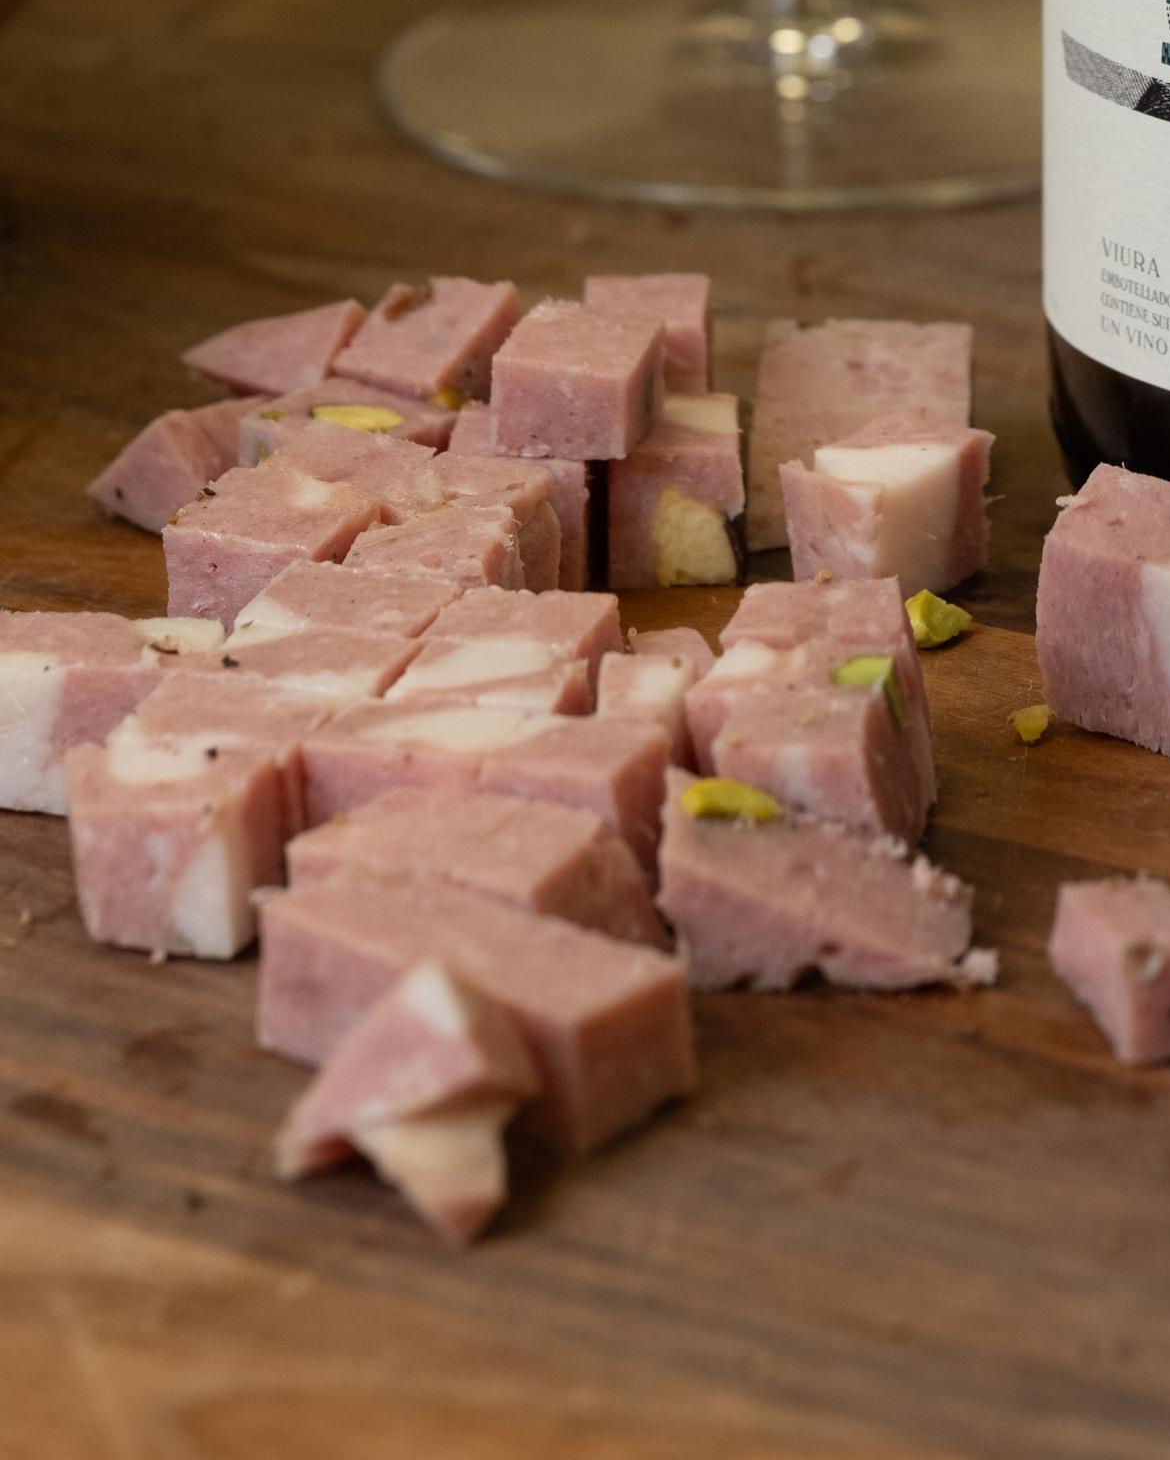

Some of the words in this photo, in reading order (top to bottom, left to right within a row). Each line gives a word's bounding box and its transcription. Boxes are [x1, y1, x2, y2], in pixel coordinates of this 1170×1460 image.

[1101, 236, 1160, 278] VIURA
[1101, 291, 1150, 324] CONTIENE
[1101, 315, 1121, 337] UN
[1126, 326, 1168, 355] VINO
